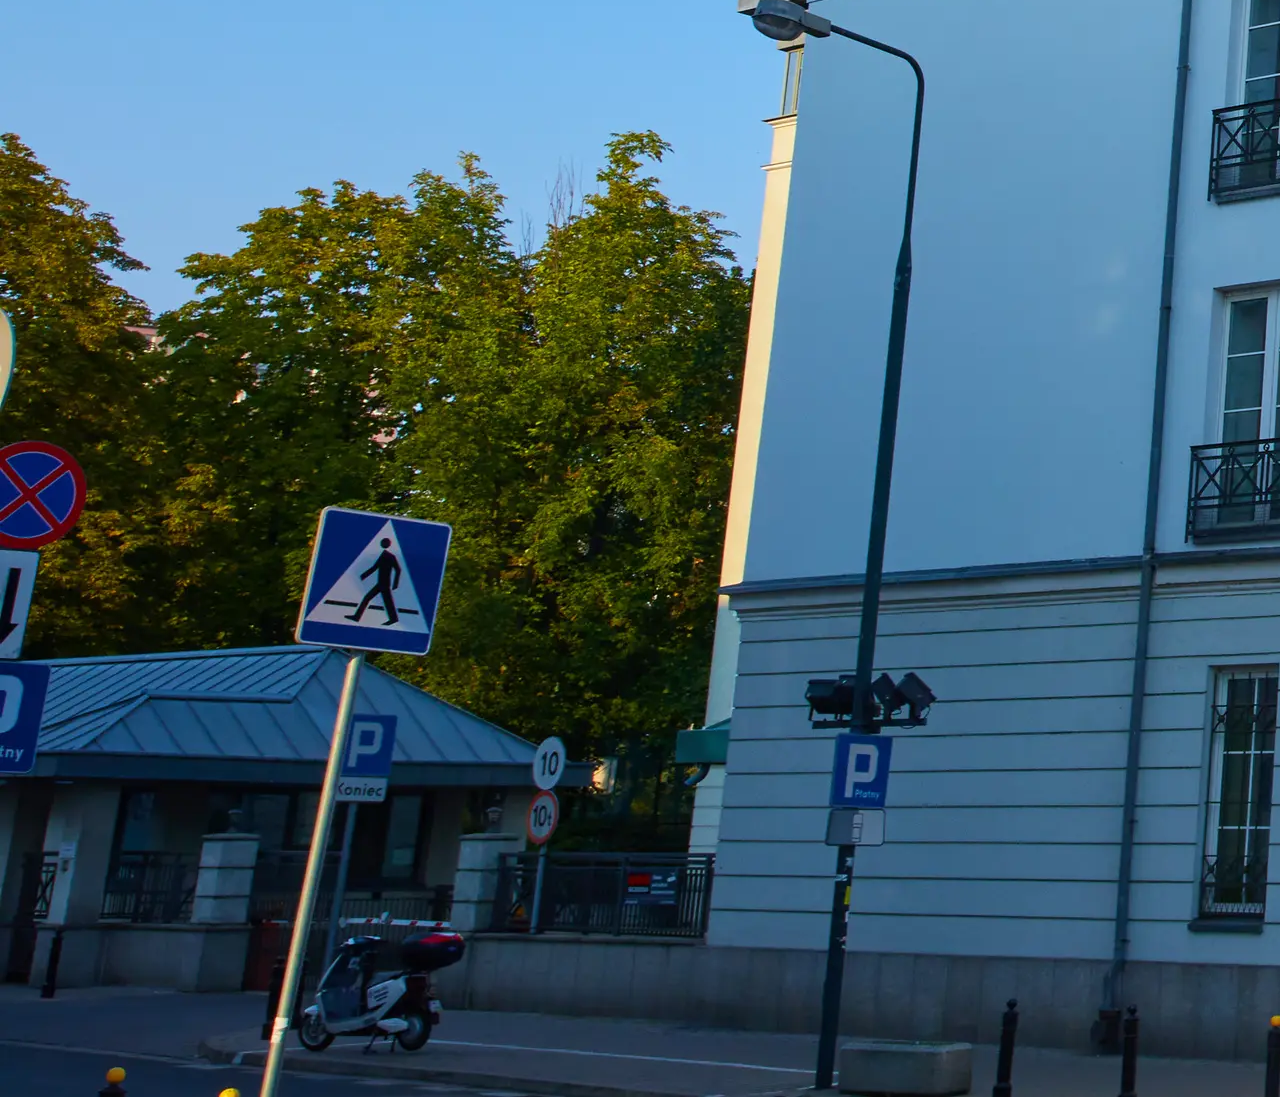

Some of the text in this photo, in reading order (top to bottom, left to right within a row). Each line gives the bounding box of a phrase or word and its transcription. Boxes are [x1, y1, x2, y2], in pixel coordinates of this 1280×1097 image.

[347, 721, 384, 768] P
[541, 751, 559, 776] 10
[844, 743, 879, 798] P
